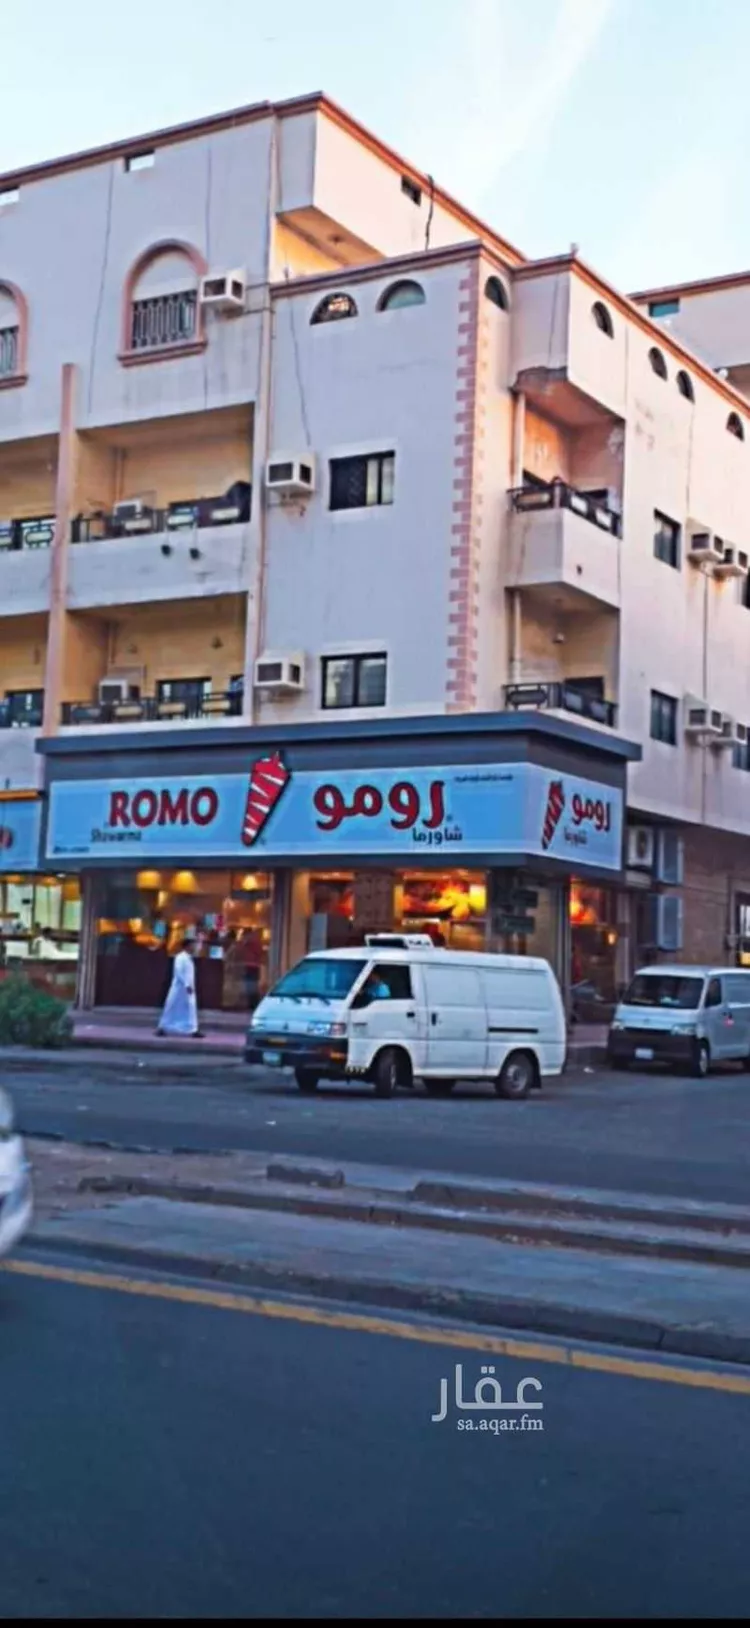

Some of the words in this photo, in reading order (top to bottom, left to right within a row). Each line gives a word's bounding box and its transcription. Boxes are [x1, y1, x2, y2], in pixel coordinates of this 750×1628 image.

[108, 786, 219, 827] ROMO
[312, 780, 446, 831] رومو
[571, 793, 611, 833] رومو
[412, 826, 463, 845] شاورما
